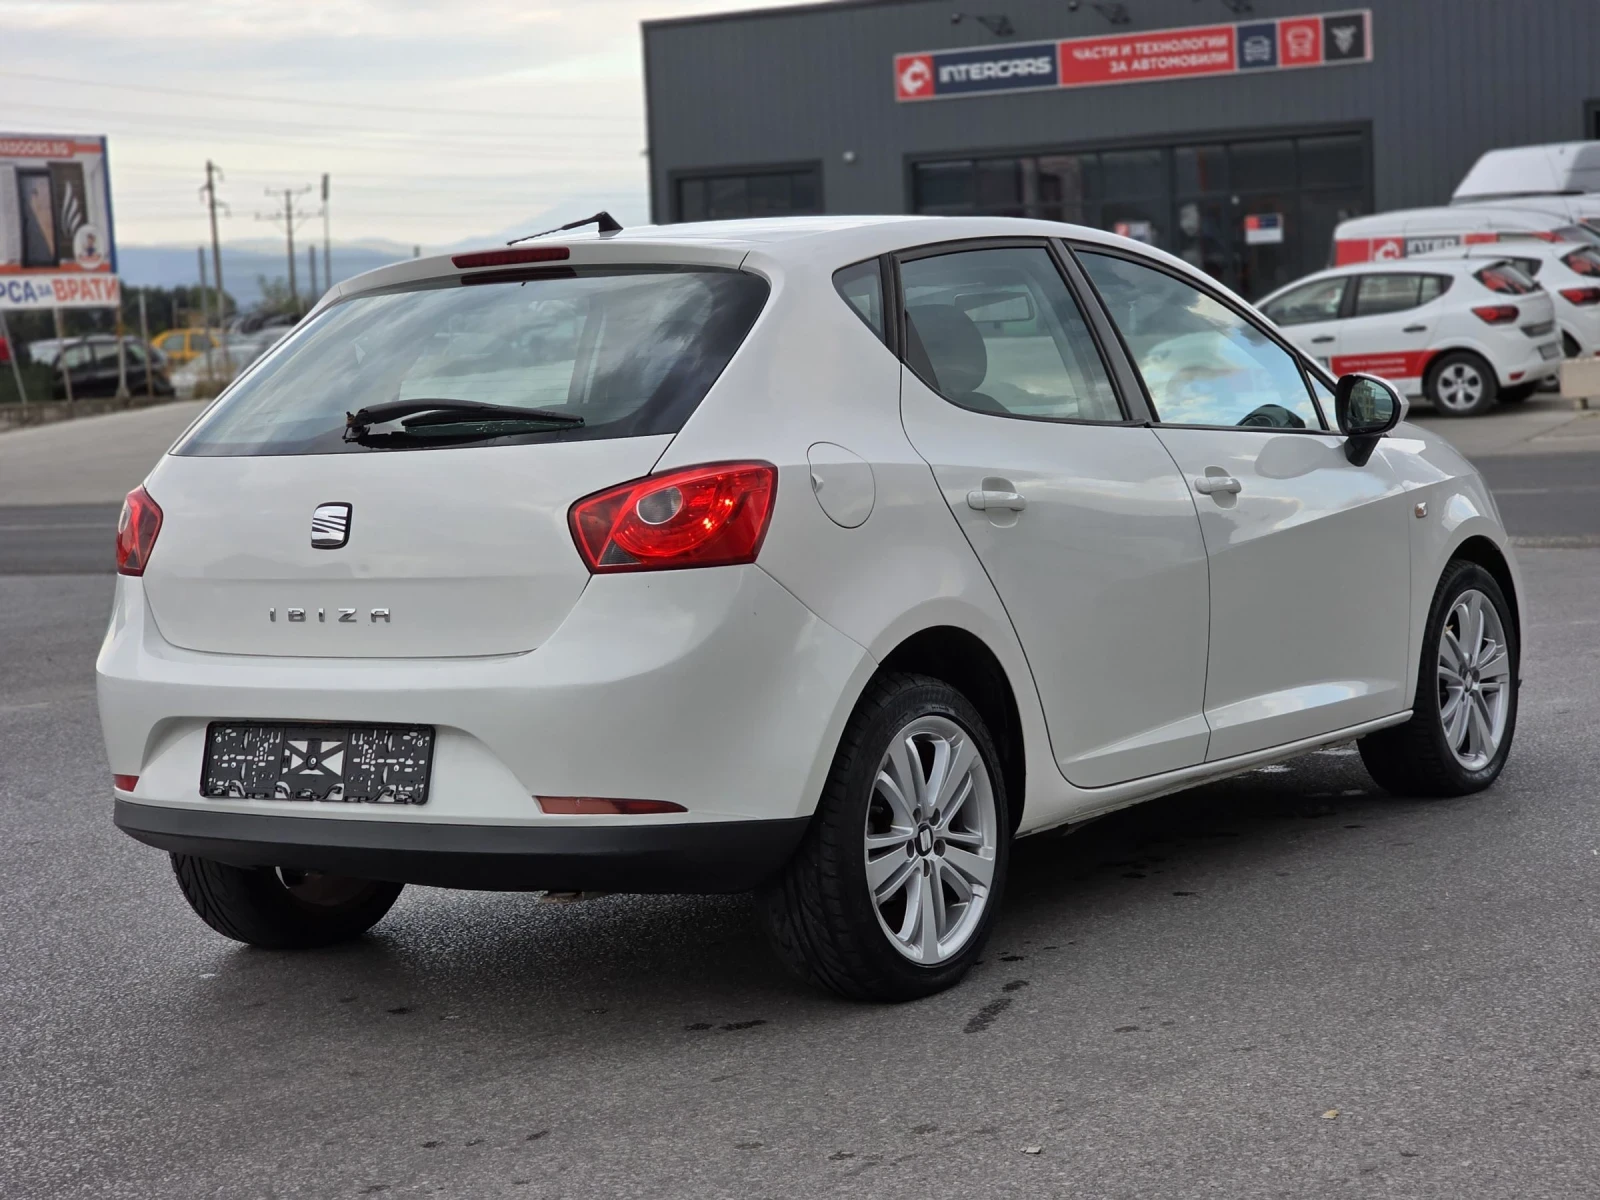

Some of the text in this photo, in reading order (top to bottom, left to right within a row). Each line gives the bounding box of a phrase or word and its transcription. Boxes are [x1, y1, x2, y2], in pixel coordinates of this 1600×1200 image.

[1072, 35, 1229, 60] ЧАСТИ И ТЕХНОЛОГИИ
[938, 57, 1052, 83] INTERCARS
[1109, 51, 1229, 74] ЗА АВТОМОБИЛИ
[52, 276, 118, 302] ВРАТИ
[269, 607, 391, 622] IBIZA
